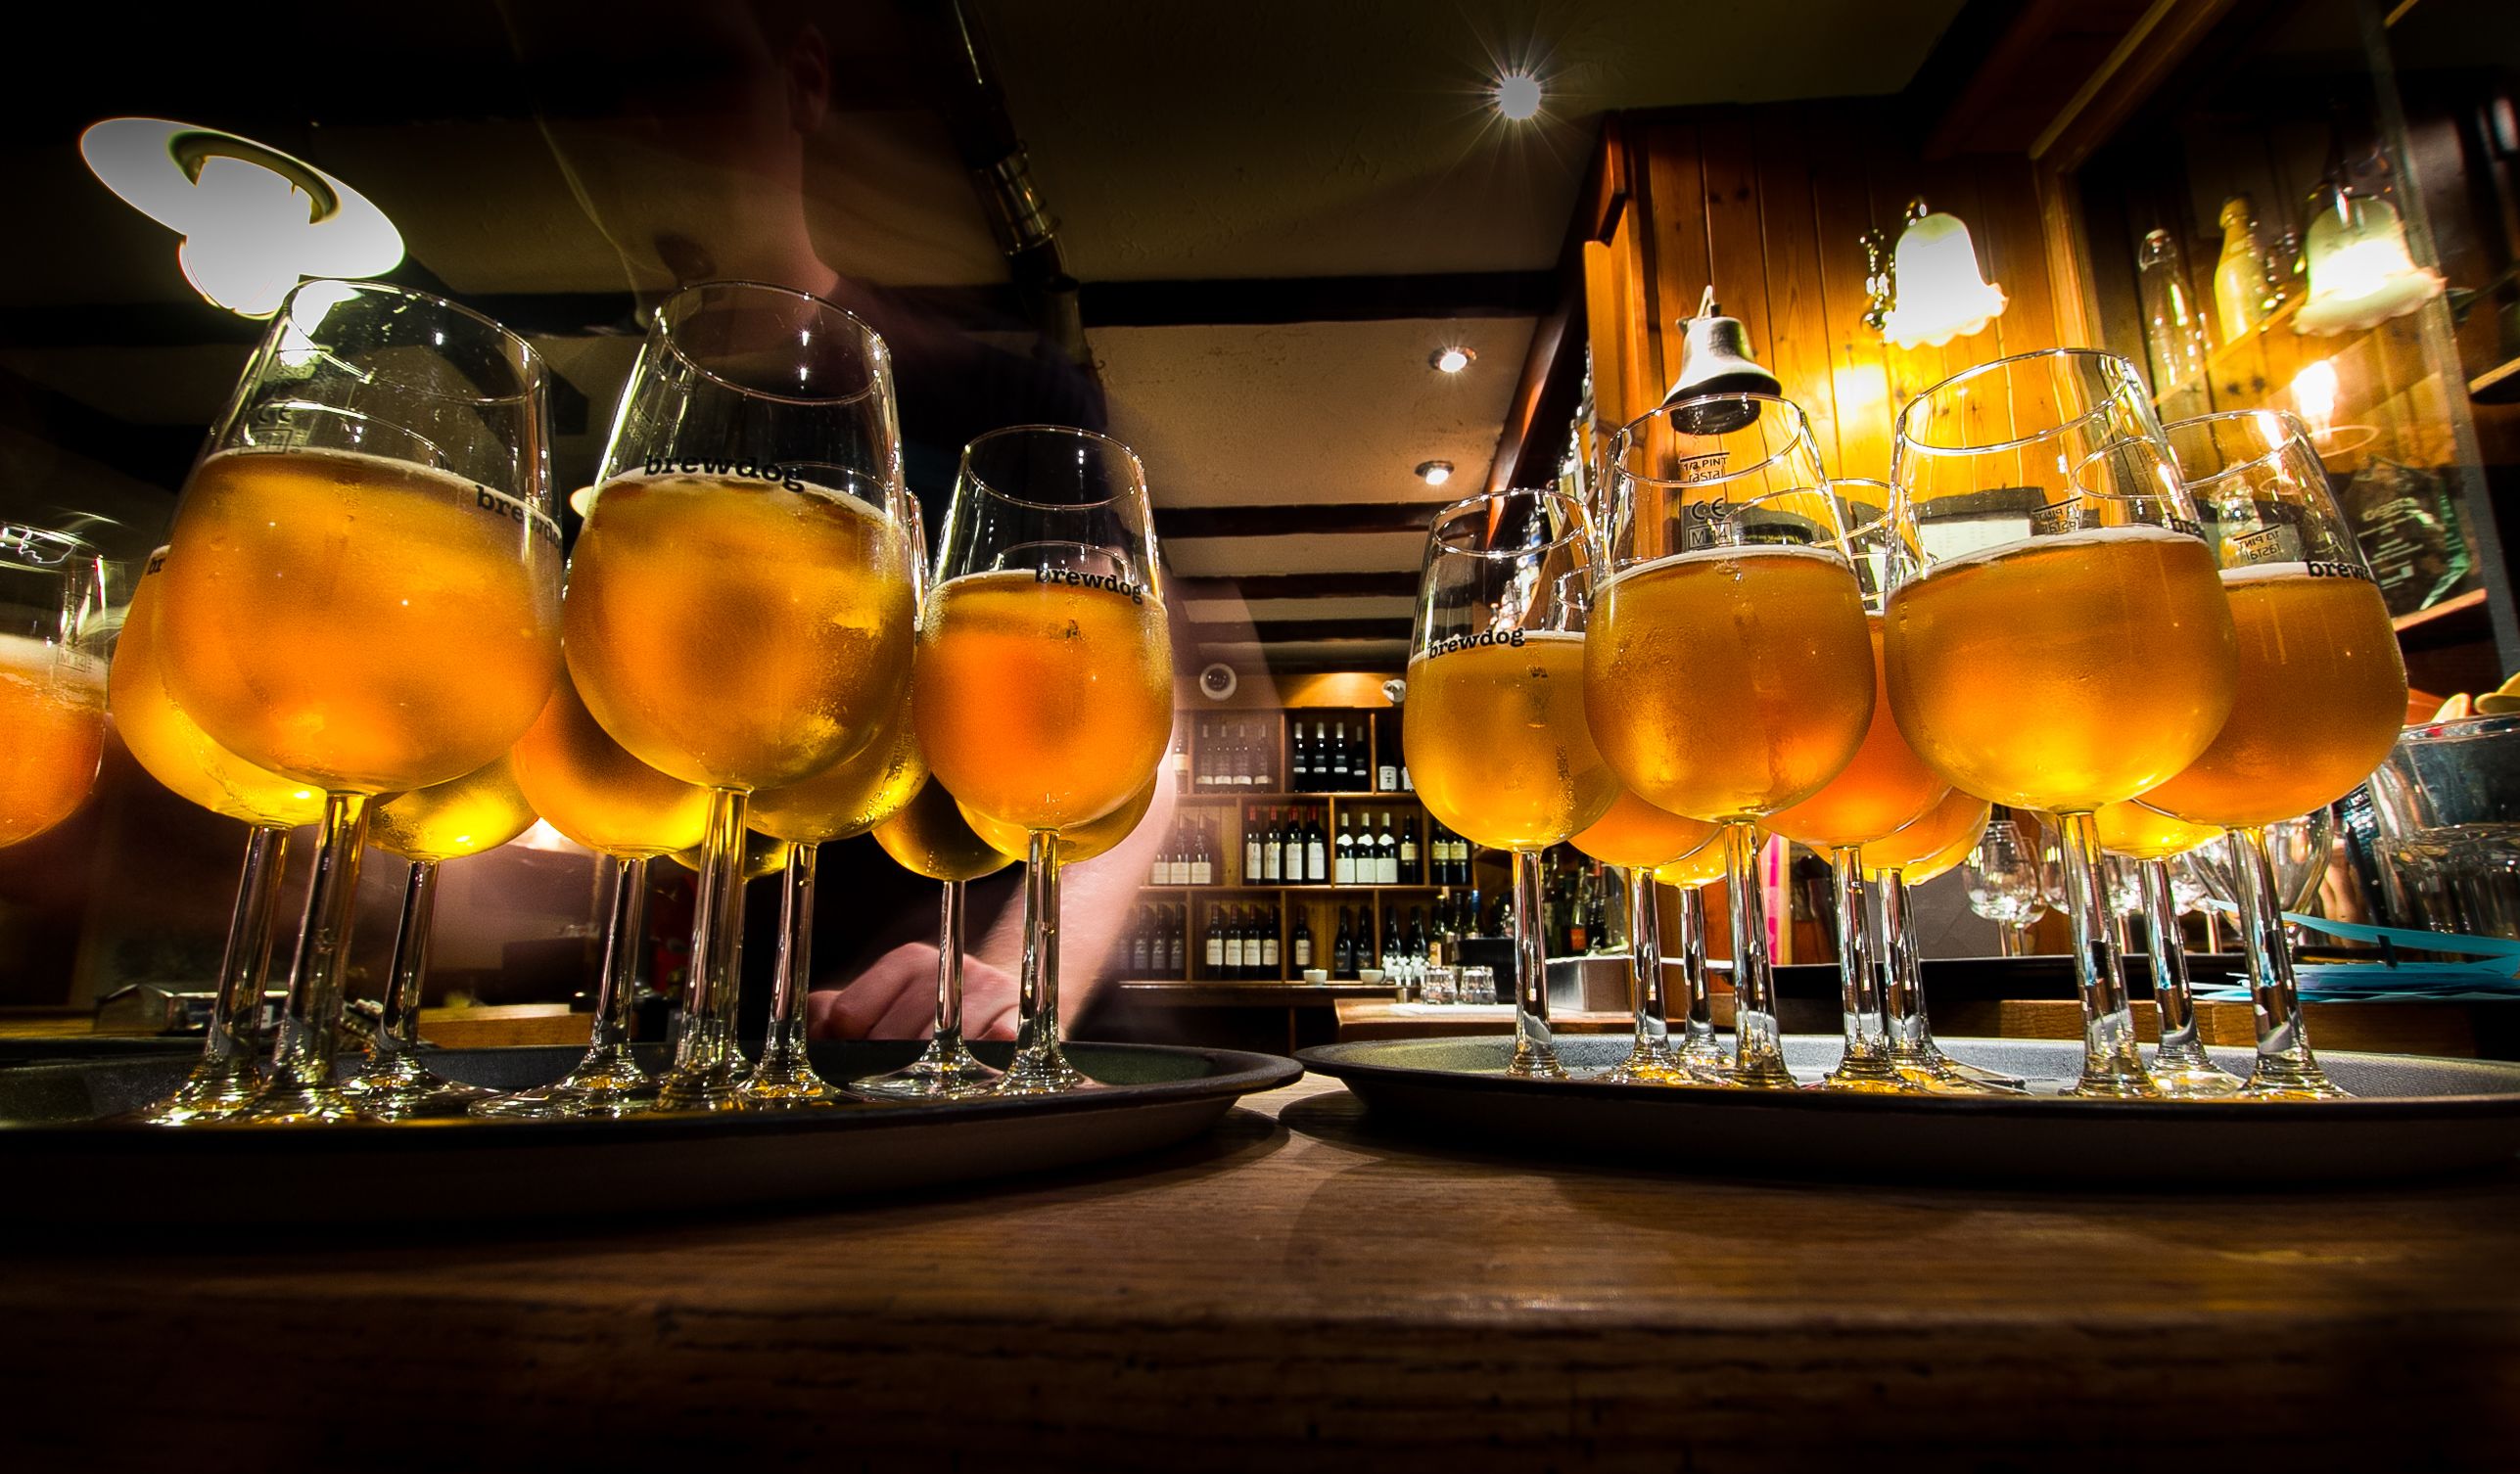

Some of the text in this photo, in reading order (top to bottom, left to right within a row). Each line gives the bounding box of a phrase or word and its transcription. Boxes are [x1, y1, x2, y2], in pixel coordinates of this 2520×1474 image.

[644, 454, 805, 493] brewdog
[1702, 457, 1728, 468] PINT
[1035, 565, 1143, 605] brewdog
[2303, 559, 2373, 584] brew
[1427, 626, 1526, 660] brewdog
